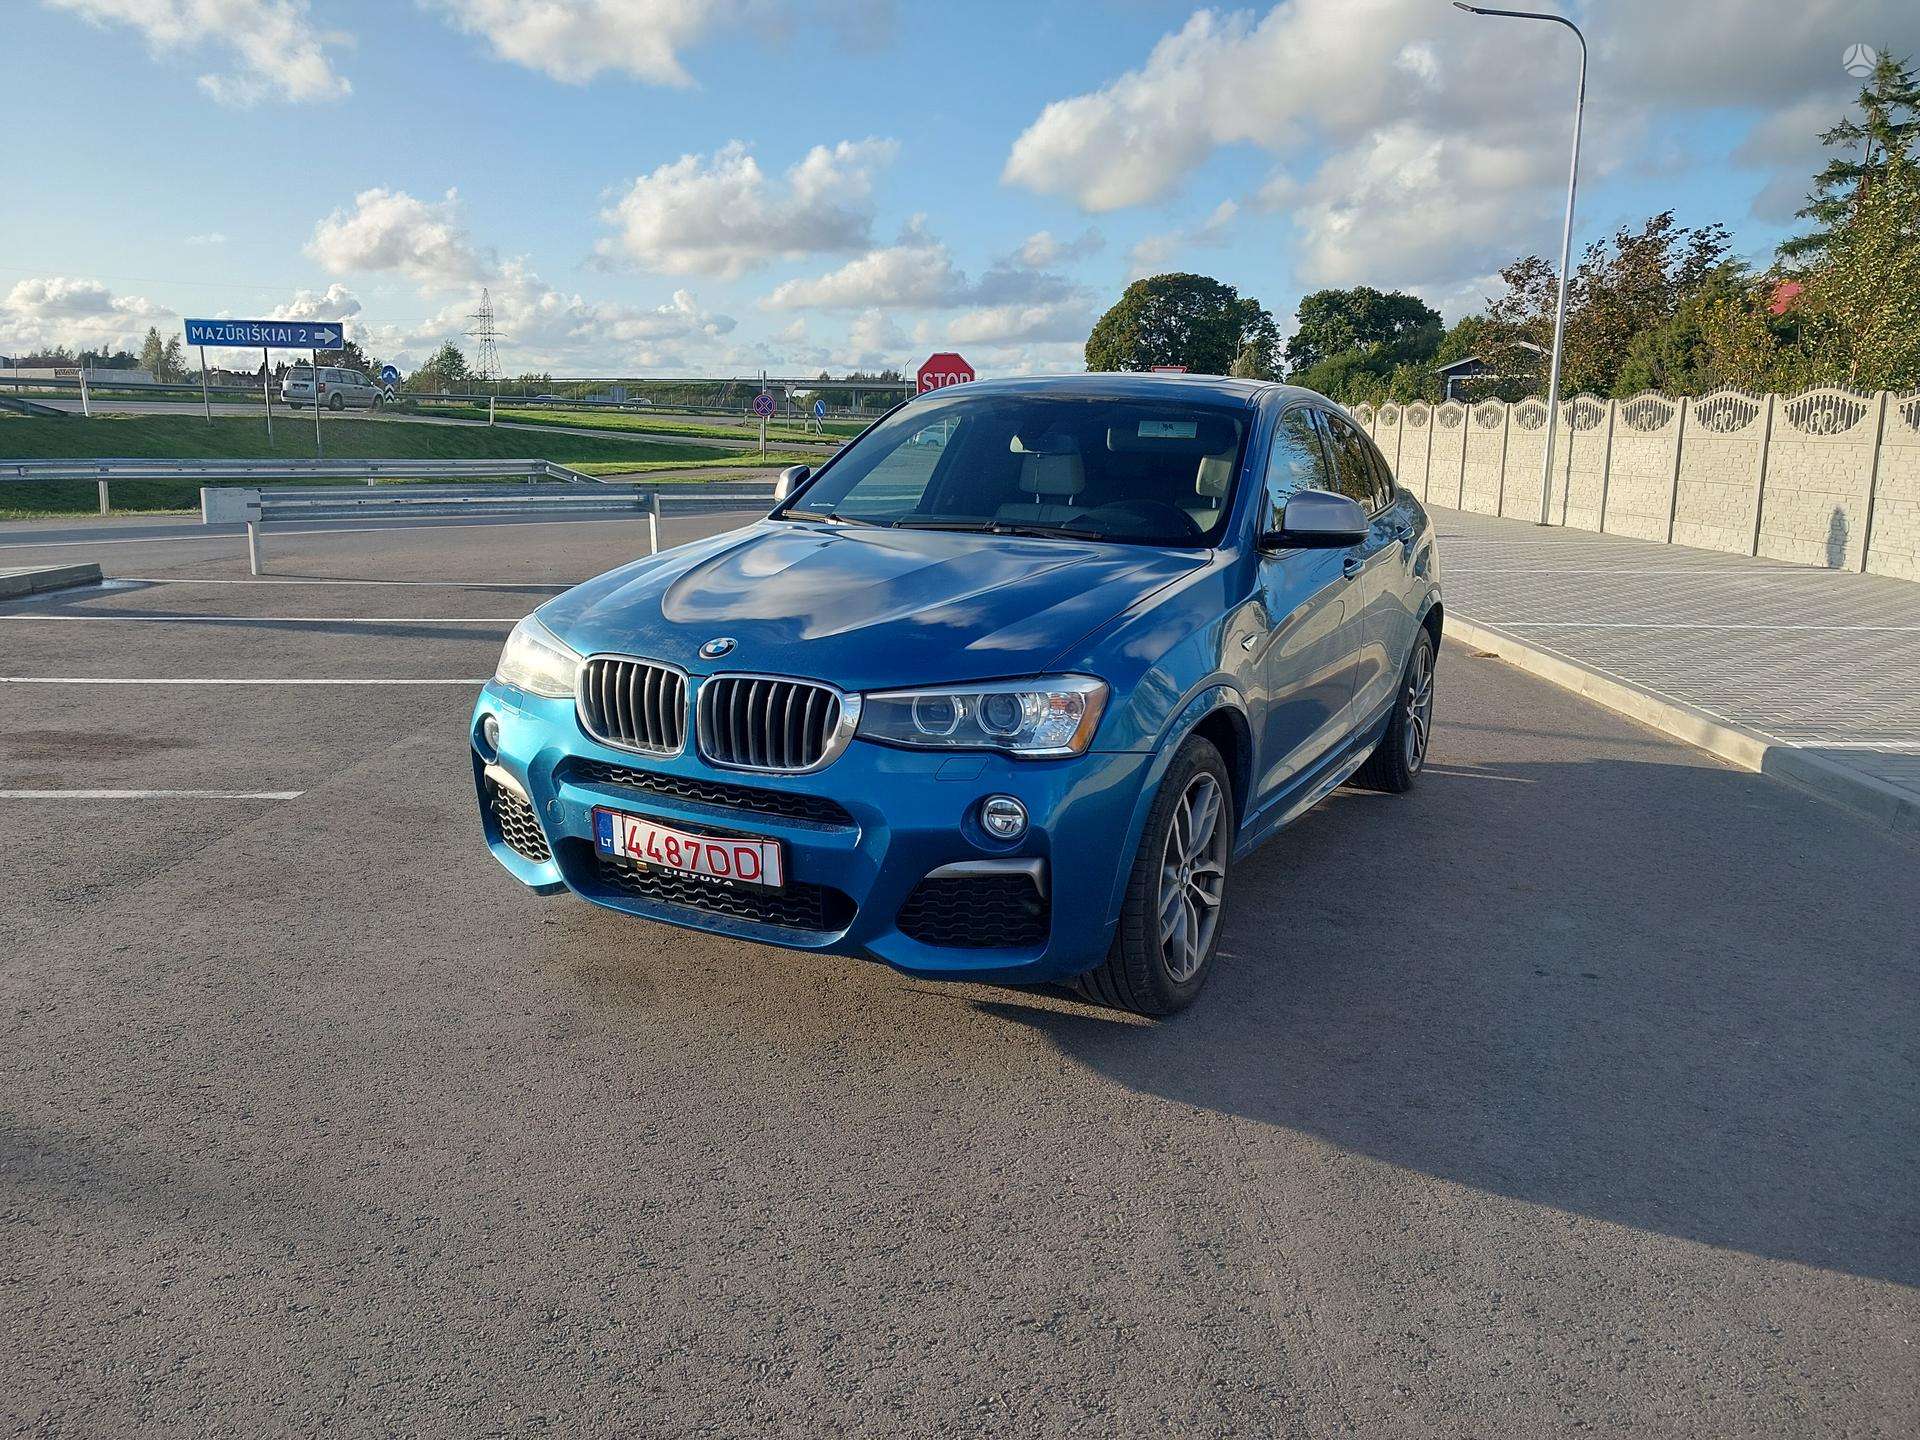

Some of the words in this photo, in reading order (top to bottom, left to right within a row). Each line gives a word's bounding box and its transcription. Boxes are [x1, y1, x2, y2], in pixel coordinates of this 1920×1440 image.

[191, 323, 292, 342] MAZŪRIŠKIAI
[299, 329, 307, 342] 2
[600, 836, 612, 848] LT
[627, 825, 760, 880] 4487DD
[663, 867, 735, 887] LIETUVA
